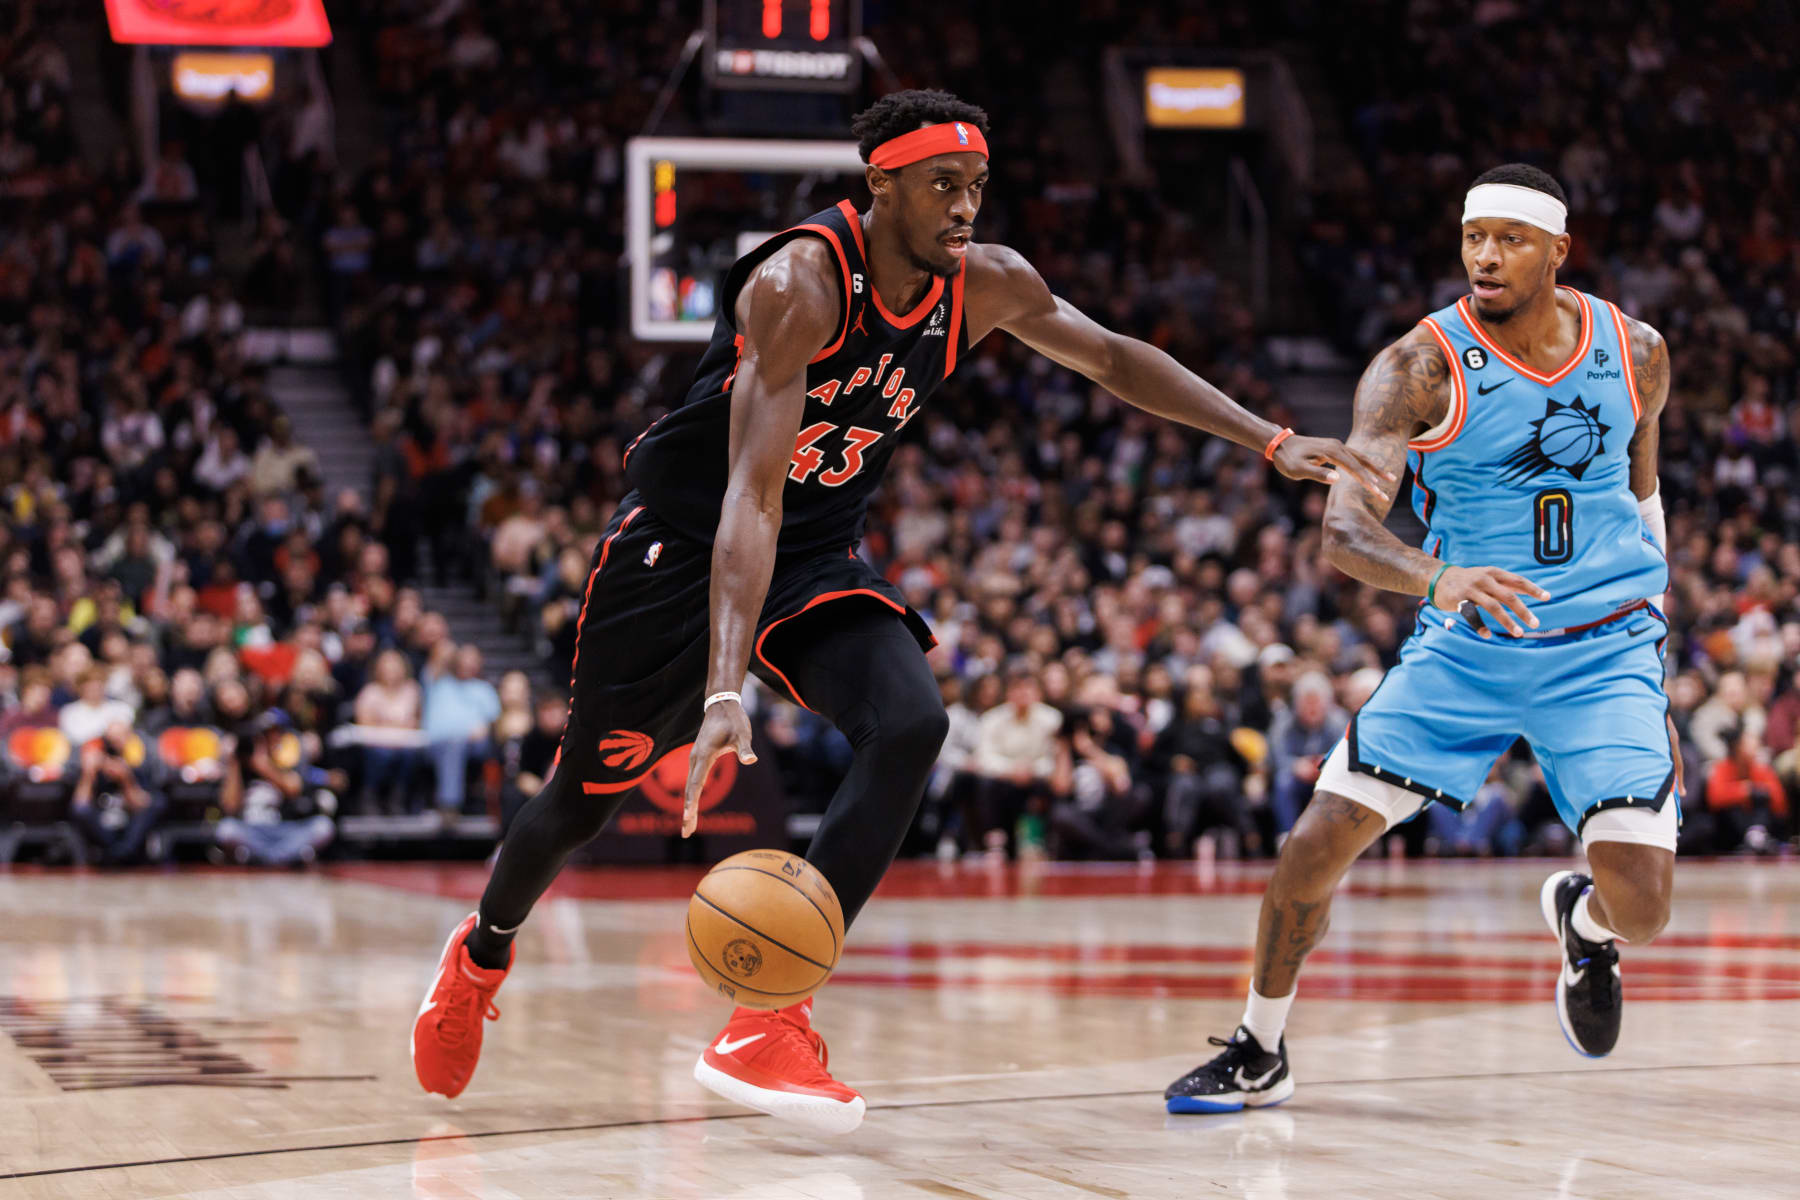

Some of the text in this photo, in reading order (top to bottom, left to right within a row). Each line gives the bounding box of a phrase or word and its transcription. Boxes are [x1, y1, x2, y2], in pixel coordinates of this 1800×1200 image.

[852, 273, 864, 294] 6
[1466, 349, 1484, 369] 6
[1587, 370, 1620, 380] PayPal
[806, 353, 920, 432] APTOR
[788, 421, 884, 487] 43
[1534, 488, 1573, 565] 0
